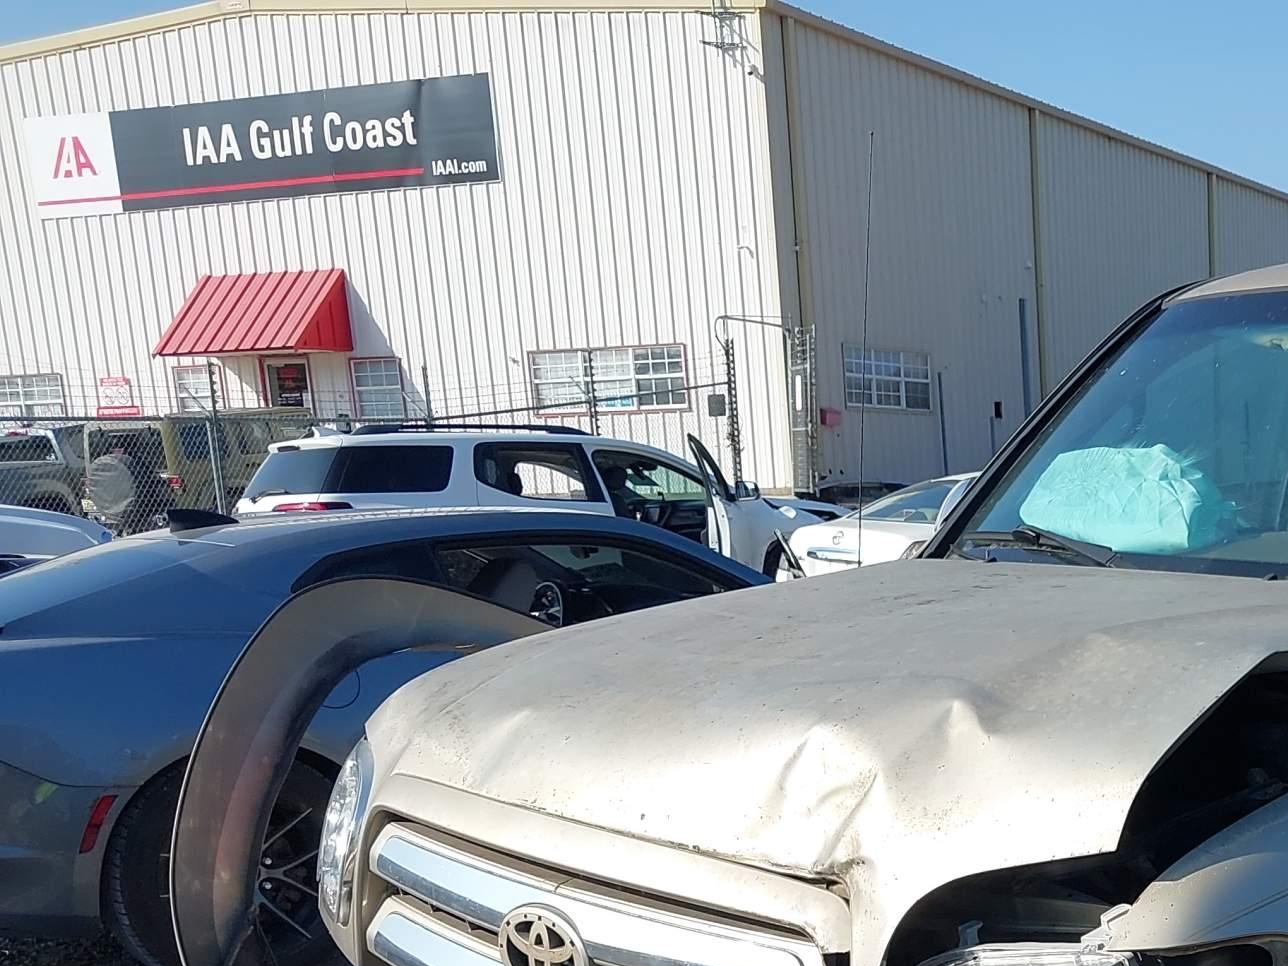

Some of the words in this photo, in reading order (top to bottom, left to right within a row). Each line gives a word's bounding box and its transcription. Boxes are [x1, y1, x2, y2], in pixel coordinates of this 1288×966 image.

[182, 124, 242, 166] IAA
[249, 114, 314, 160] Gulf
[322, 109, 418, 153] Coast
[431, 159, 488, 177] IAAI.com
